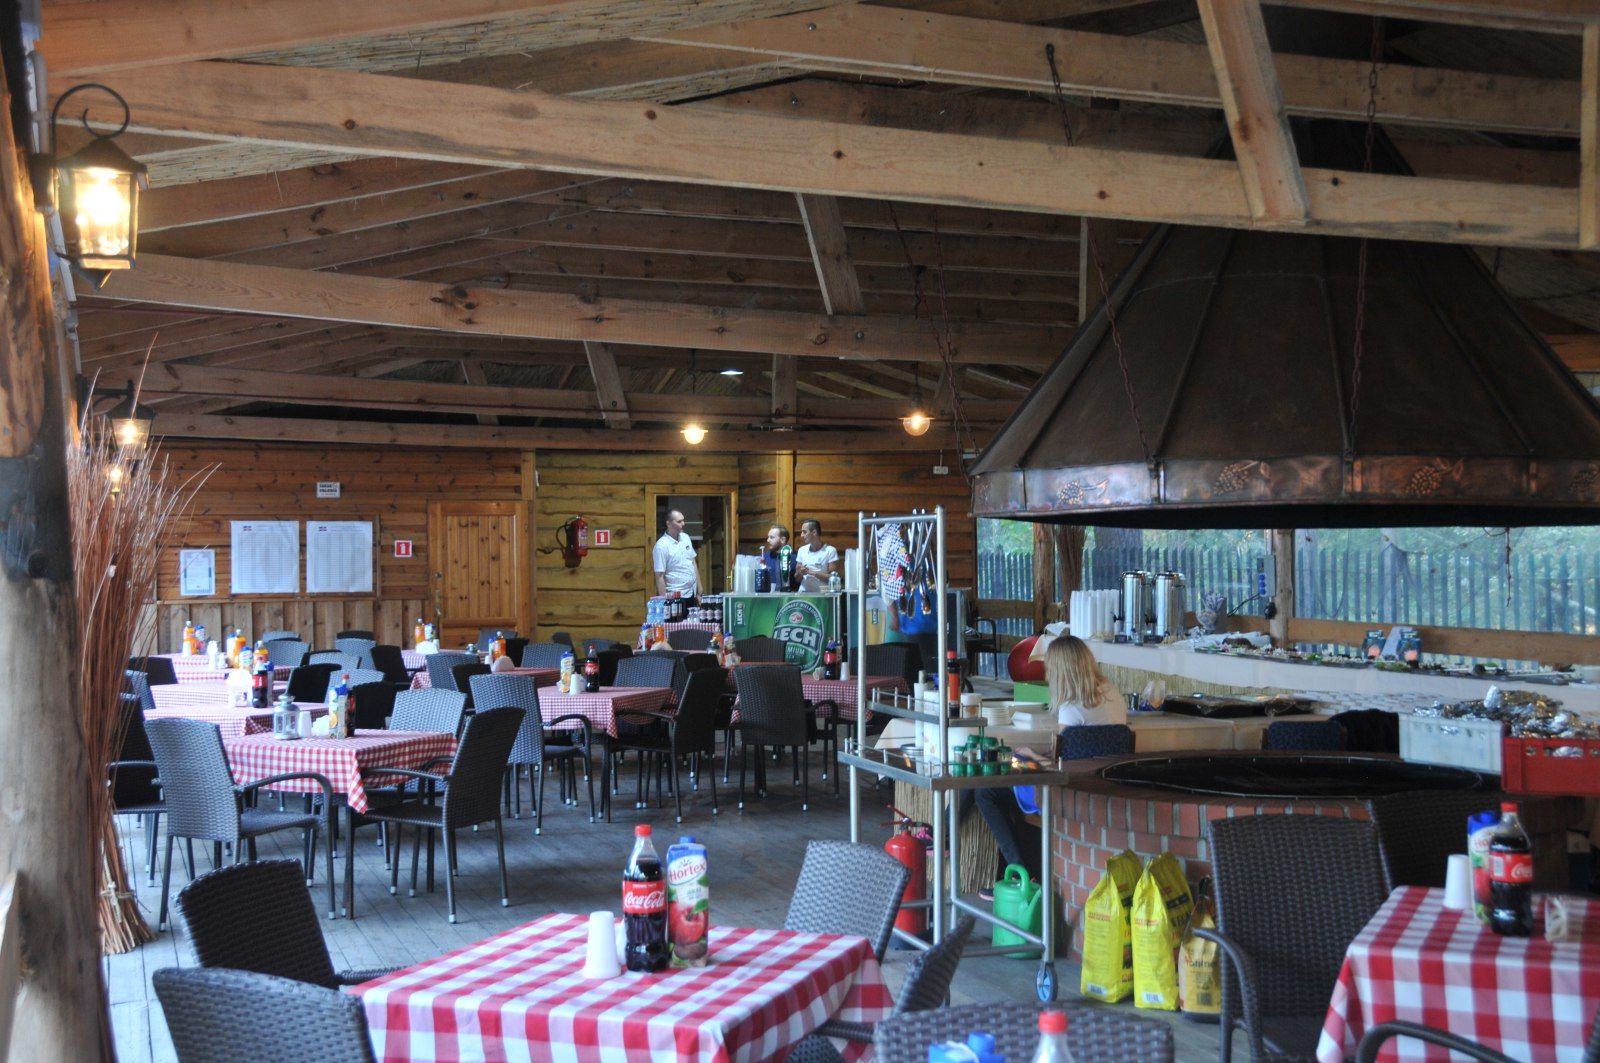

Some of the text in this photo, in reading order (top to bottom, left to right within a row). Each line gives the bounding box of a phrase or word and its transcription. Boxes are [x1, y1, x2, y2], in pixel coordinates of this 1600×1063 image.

[773, 627, 817, 648] LECH
[669, 863, 705, 881] Hortex
[624, 891, 665, 909] Coca-Cola
